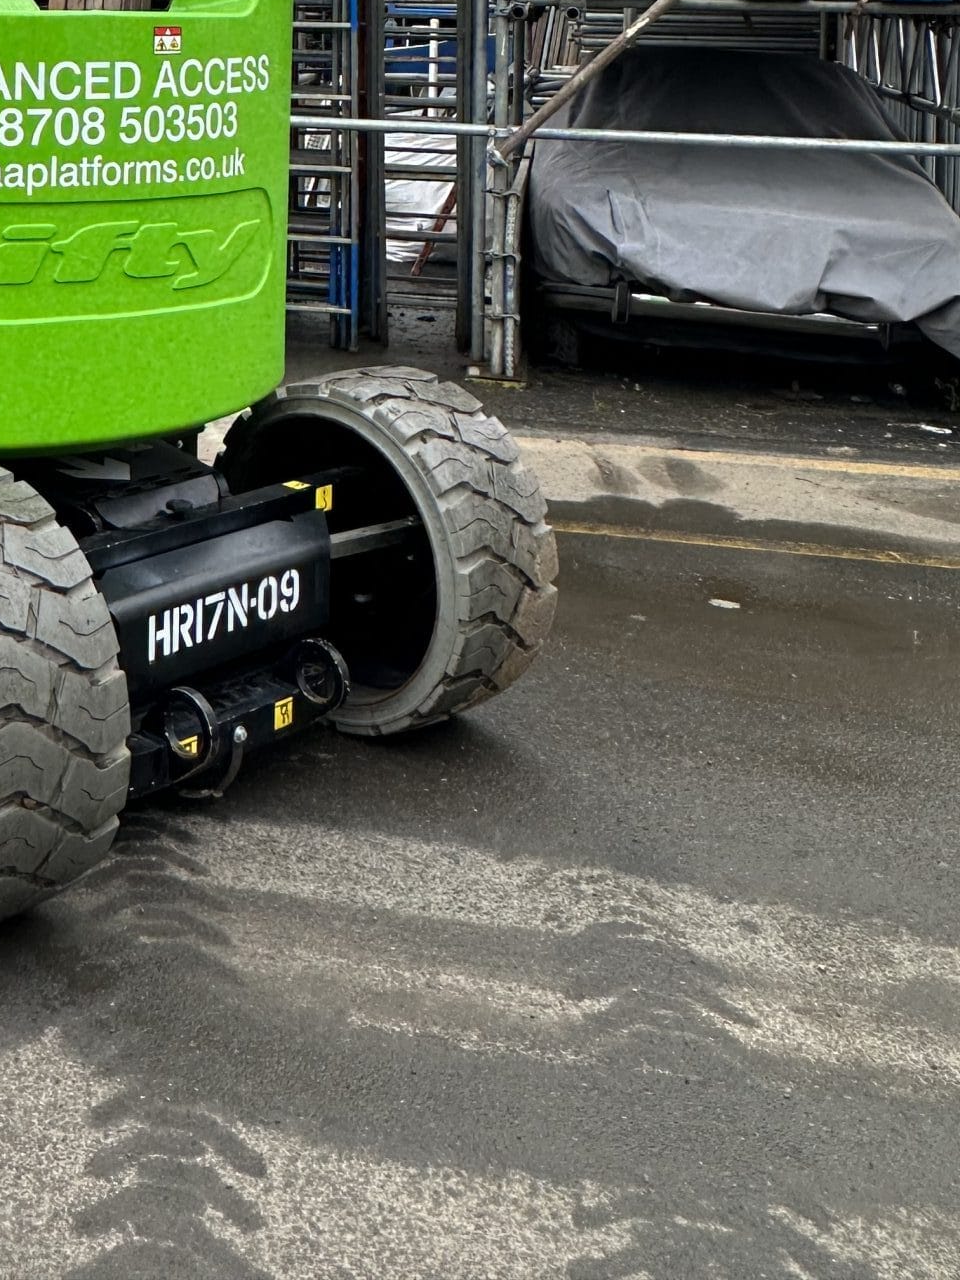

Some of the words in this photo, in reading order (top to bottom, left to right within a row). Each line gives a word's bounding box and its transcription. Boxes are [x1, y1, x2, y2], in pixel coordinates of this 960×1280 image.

[153, 54, 270, 98] ACCESS
[119, 101, 238, 145] 503503
[148, 569, 300, 662] HR17N-09
